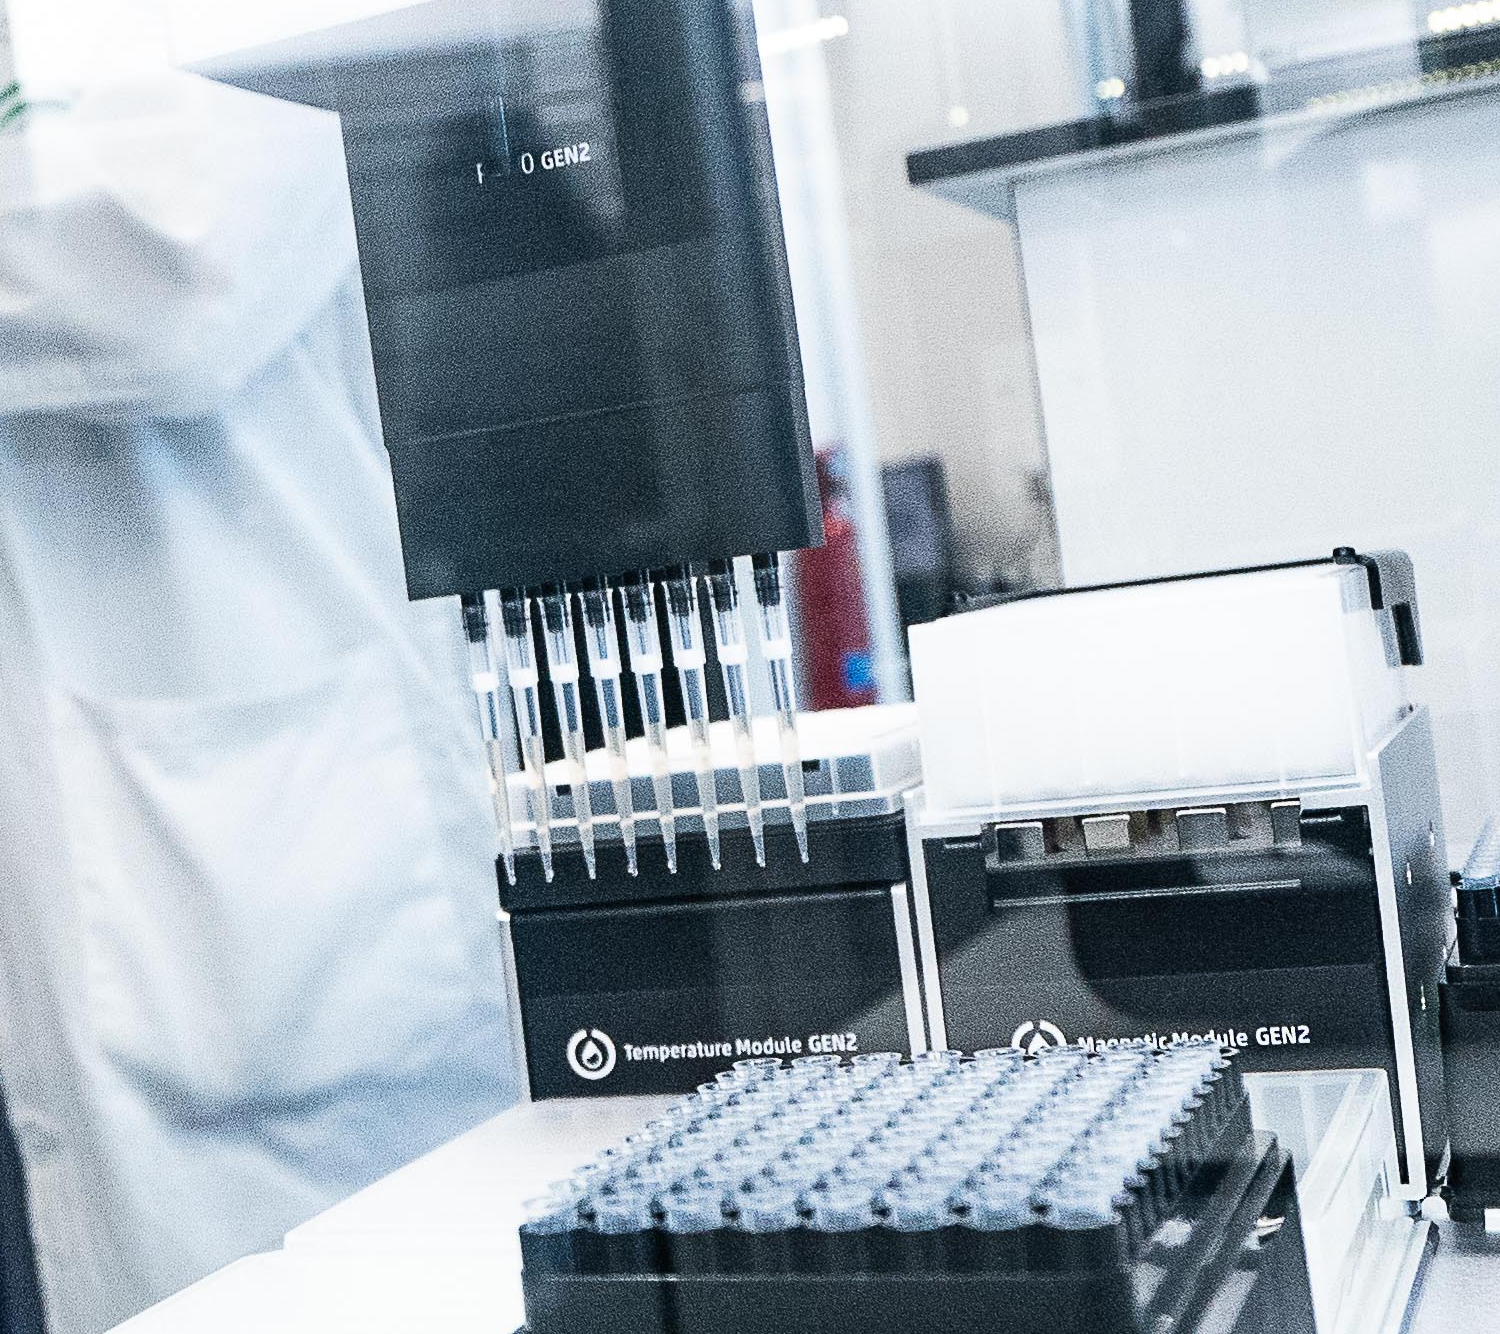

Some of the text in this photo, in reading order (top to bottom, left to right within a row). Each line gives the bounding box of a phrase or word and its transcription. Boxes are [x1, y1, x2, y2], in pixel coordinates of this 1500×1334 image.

[541, 142, 591, 170] GEN2
[623, 1033, 859, 1063] Temperature Module GEN2
[1255, 1025, 1311, 1045] GEN2
